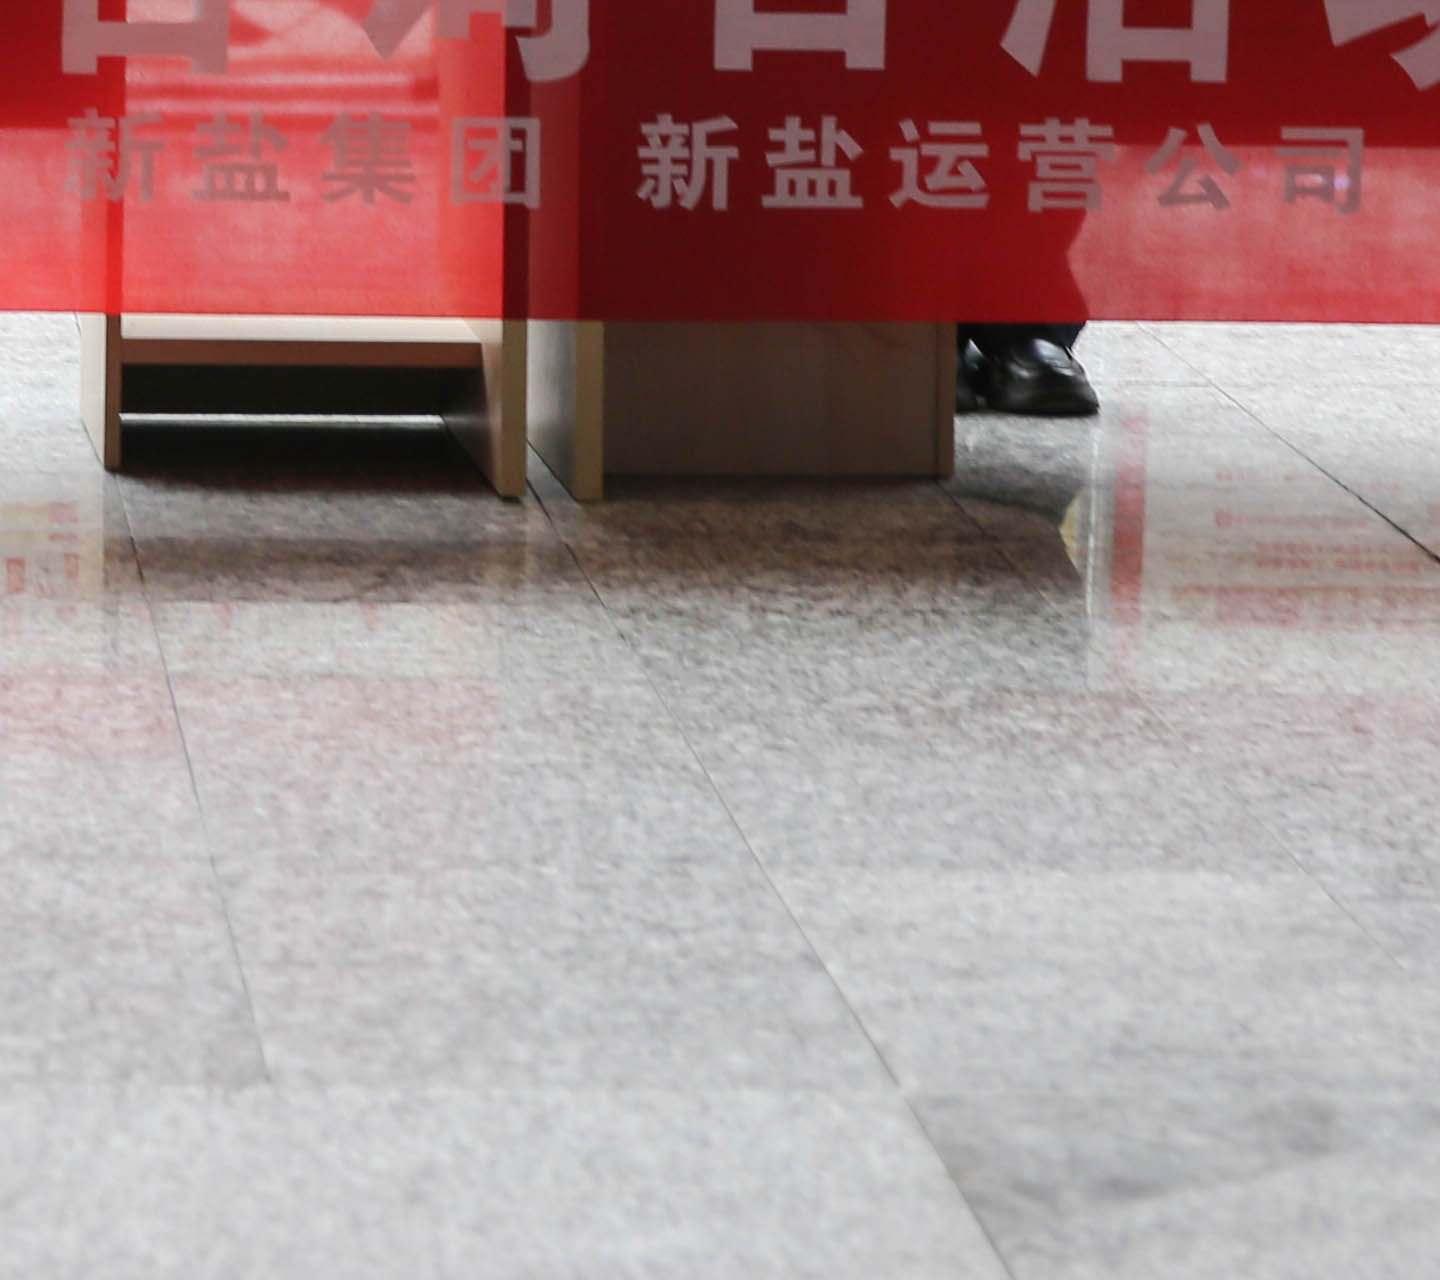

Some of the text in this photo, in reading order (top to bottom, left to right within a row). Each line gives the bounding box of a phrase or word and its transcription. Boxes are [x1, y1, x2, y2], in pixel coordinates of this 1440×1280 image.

[61, 108, 544, 211] 新盐集团
[635, 112, 1366, 217] 新盐运营公司
